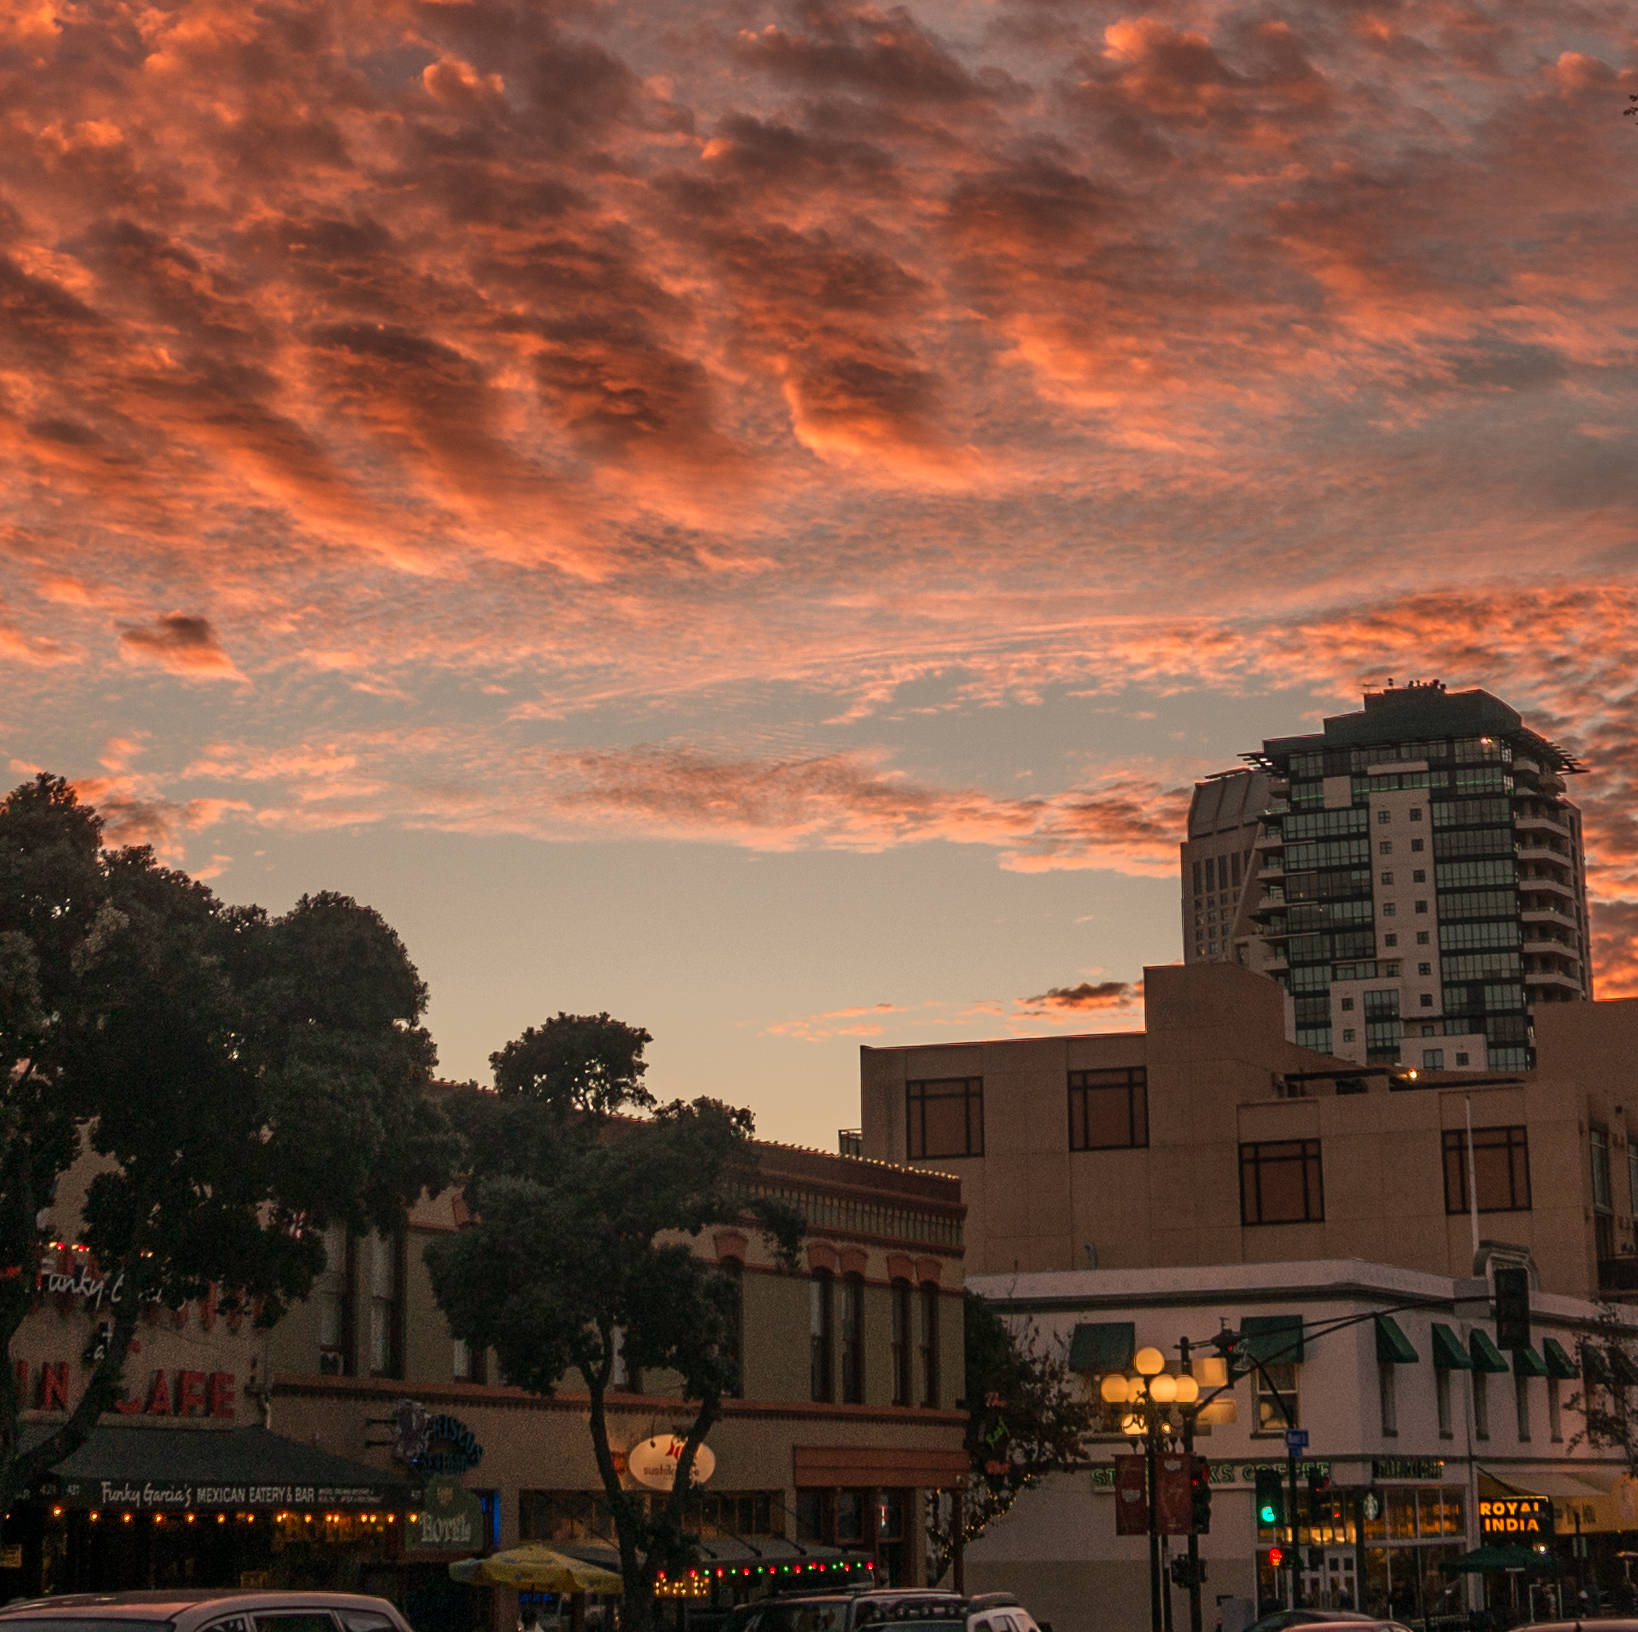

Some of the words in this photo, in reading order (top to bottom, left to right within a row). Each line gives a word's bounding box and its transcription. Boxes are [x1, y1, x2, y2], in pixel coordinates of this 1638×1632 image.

[100, 1480, 141, 1507] Funky
[143, 1481, 191, 1507] Garcia's
[196, 1487, 245, 1504] MEXICAN
[249, 1486, 285, 1504] EATERY
[294, 1487, 315, 1504] BAR
[1484, 1518, 1540, 1533] INDIA
